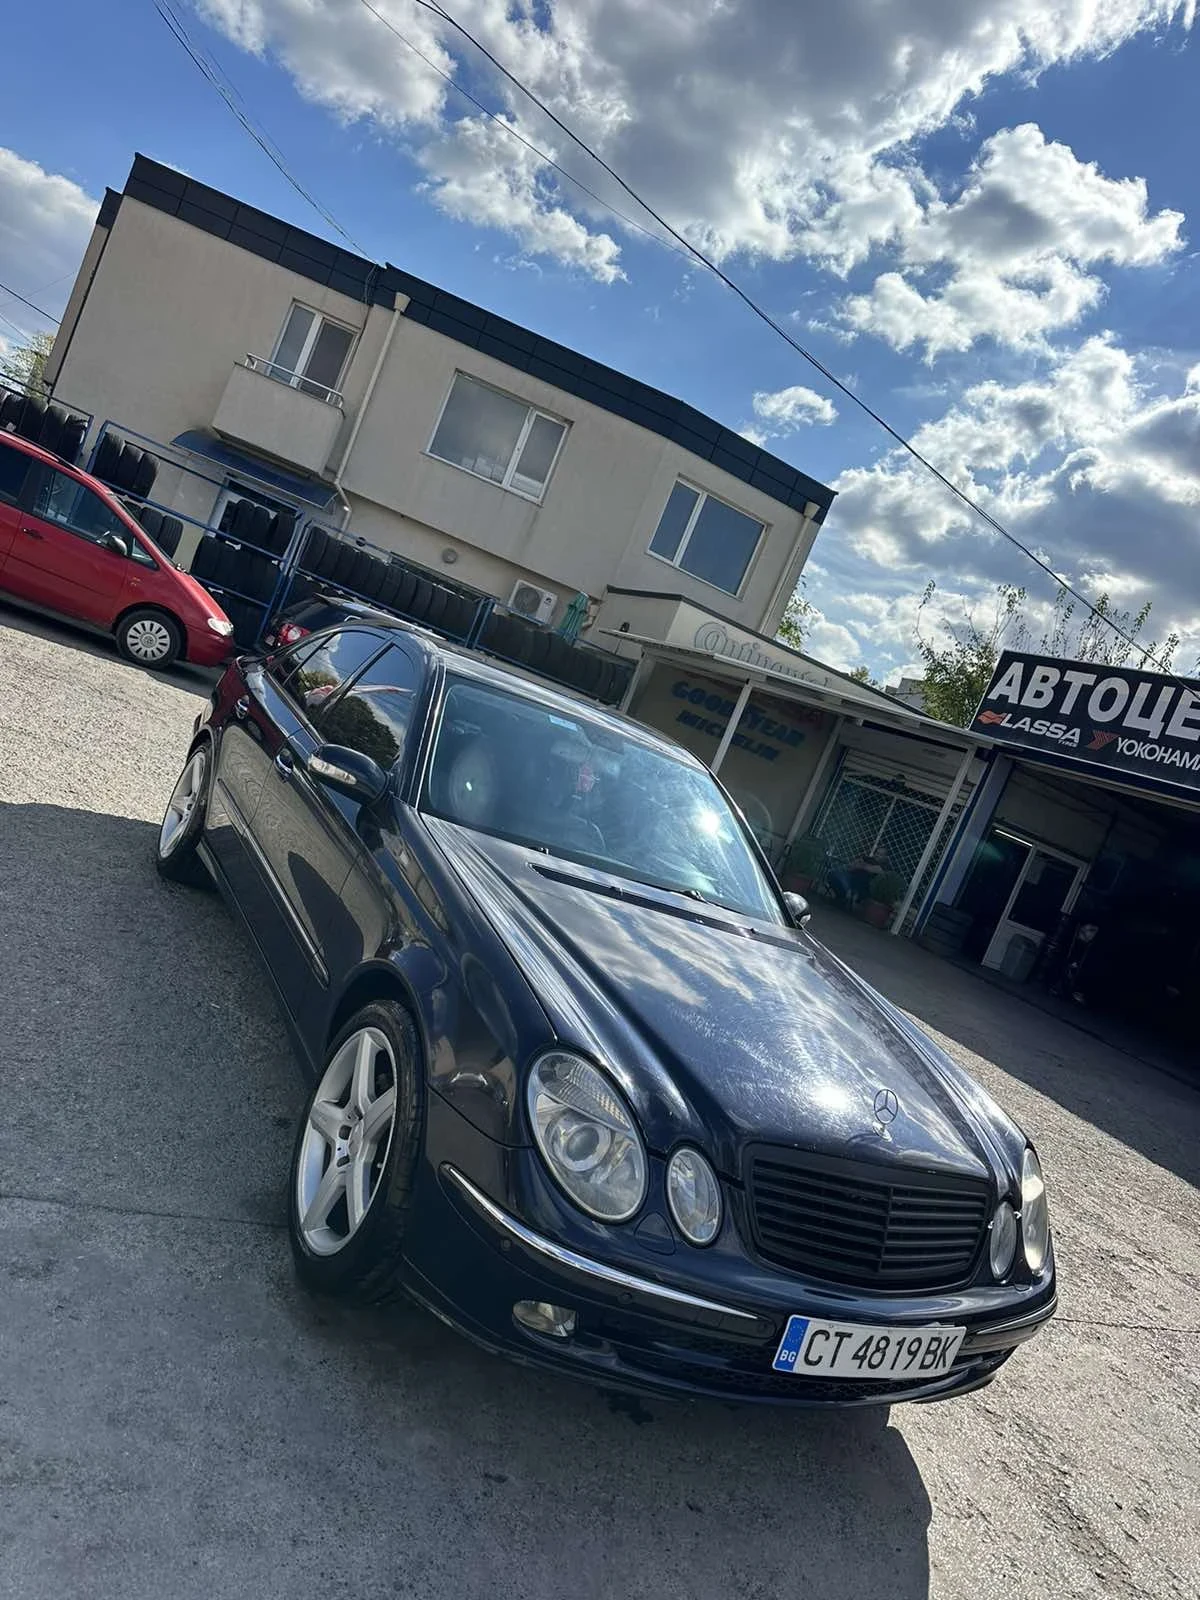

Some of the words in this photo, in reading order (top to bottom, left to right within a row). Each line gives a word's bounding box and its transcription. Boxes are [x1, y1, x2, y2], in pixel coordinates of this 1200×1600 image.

[987, 662, 1200, 740] АВТОЦЕ
[1000, 713, 1081, 743] LASSA
[779, 1350, 796, 1362] BG
[803, 1329, 853, 1368] CT
